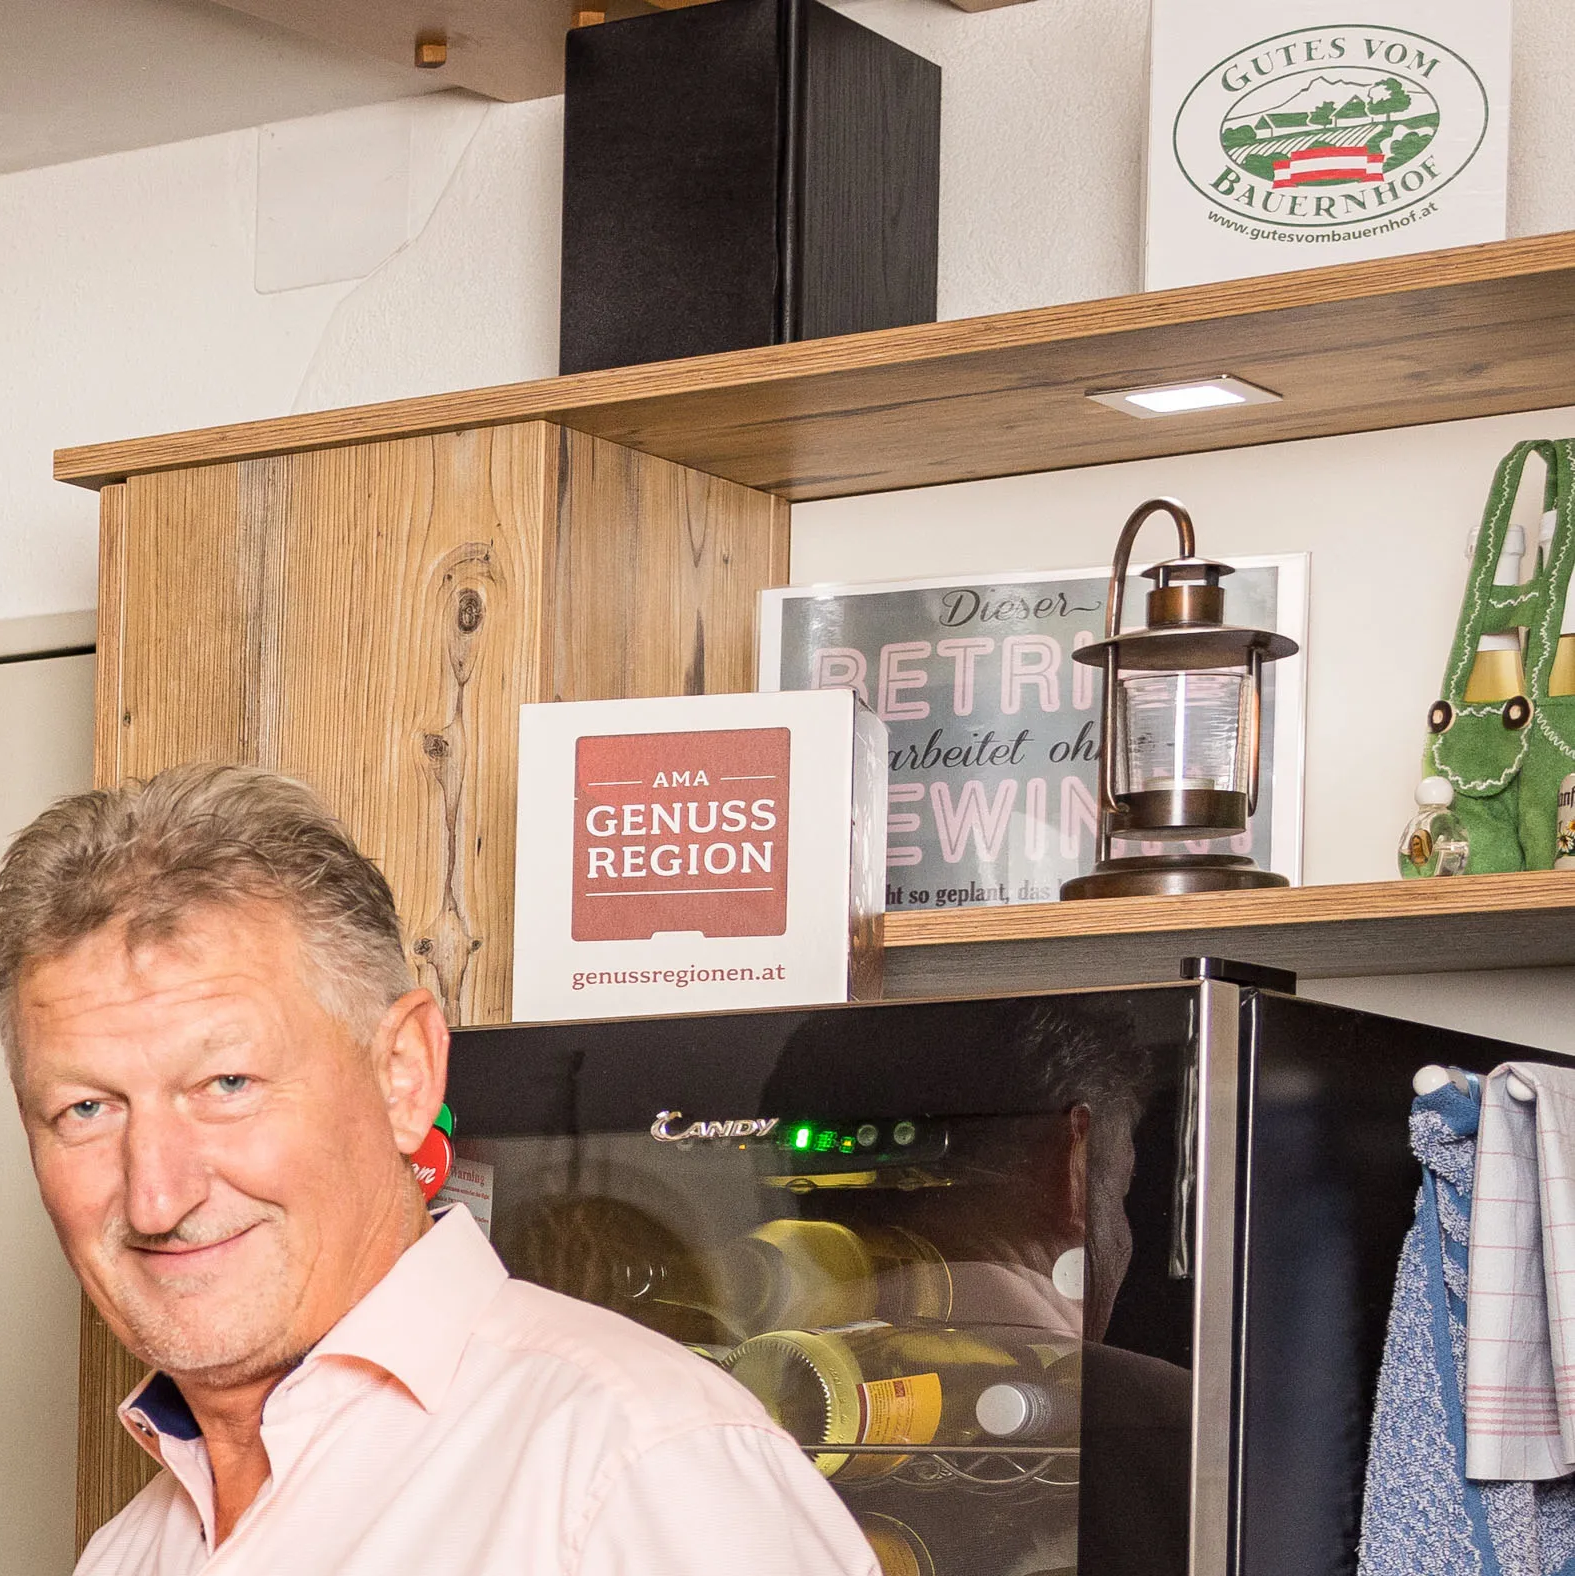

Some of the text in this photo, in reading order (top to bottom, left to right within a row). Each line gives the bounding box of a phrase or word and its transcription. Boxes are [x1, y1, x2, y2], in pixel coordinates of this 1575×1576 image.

[1221, 37, 1441, 93] GUTES VOM
[1209, 154, 1443, 220] BAUERNHOF
[1207, 201, 1439, 244] www.gutesvombauernhof.at
[938, 588, 1102, 628] Dieser
[652, 770, 710, 788] AMA
[585, 799, 777, 837] GENUSS
[587, 841, 774, 879] REGION
[909, 887, 930, 903] so
[935, 882, 1011, 907] geplant,
[572, 963, 786, 990] genussregionen.at
[651, 1110, 779, 1142] CANDY
